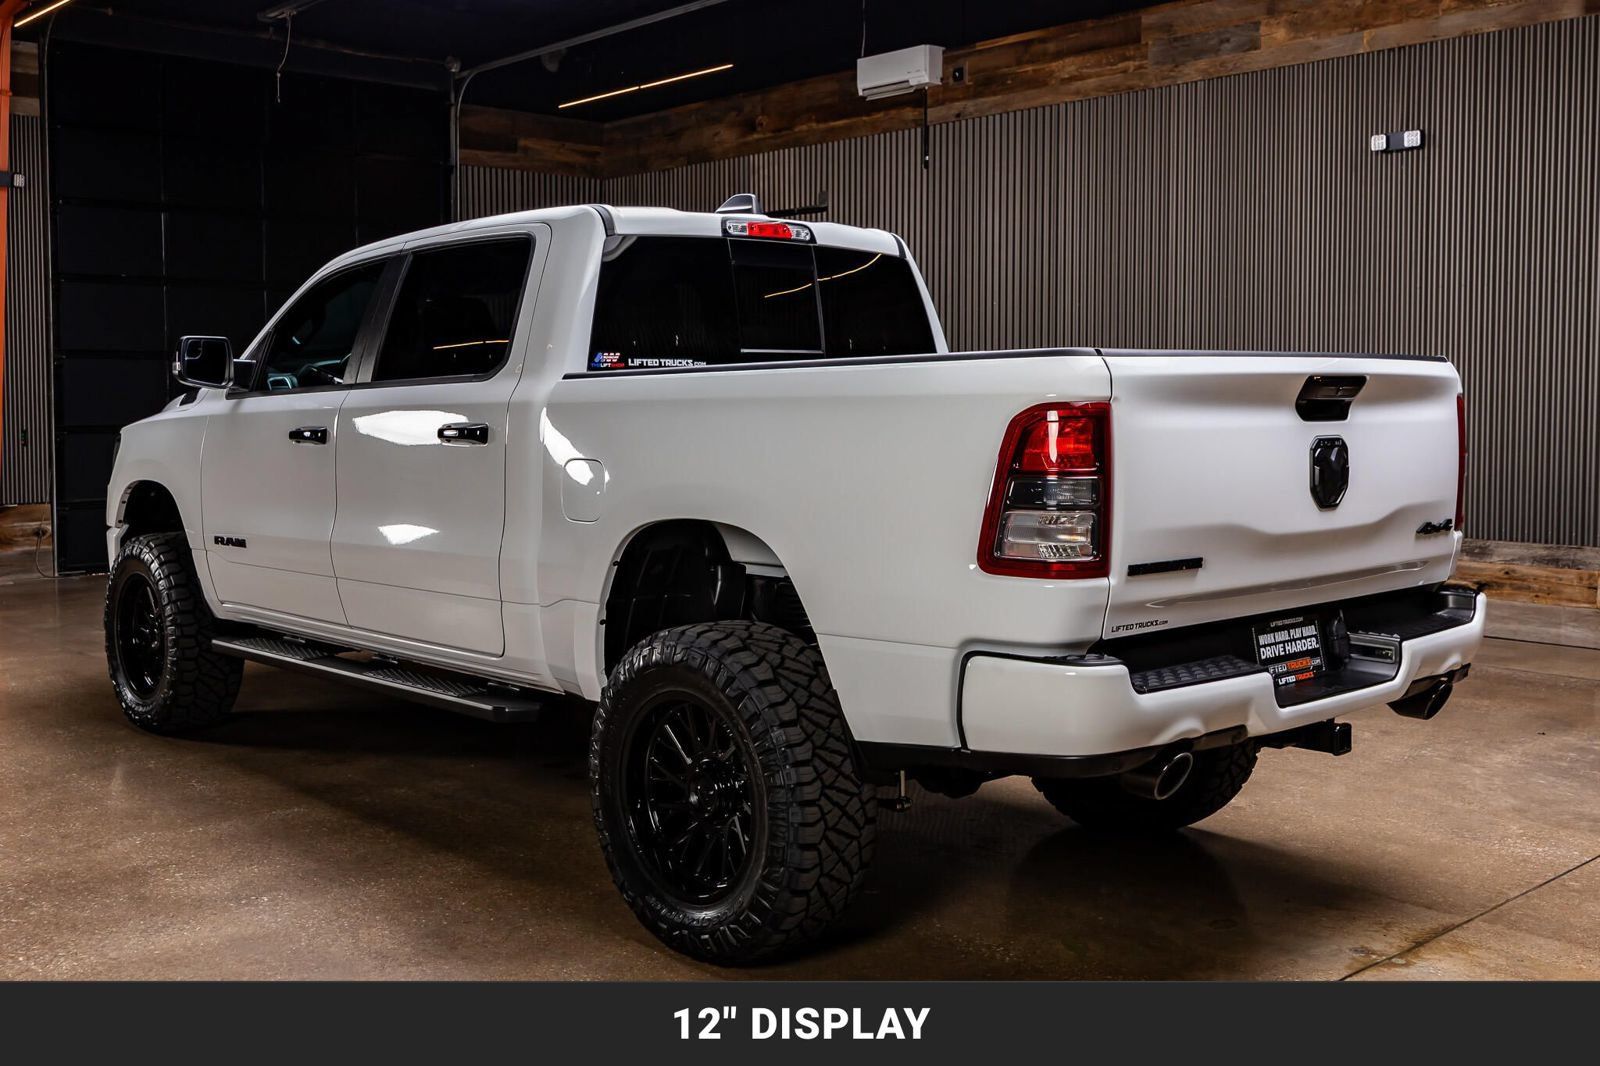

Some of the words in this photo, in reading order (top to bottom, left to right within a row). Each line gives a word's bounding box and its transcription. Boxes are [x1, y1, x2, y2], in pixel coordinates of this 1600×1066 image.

[628, 358, 659, 367] LIFTED
[214, 535, 247, 548] RAM
[1111, 624, 1134, 632] LIFTED
[1258, 633, 1275, 645] WORK
[1290, 628, 1302, 639] PLAY
[1260, 643, 1285, 660] DRIVE
[1285, 637, 1319, 654] HARDER.
